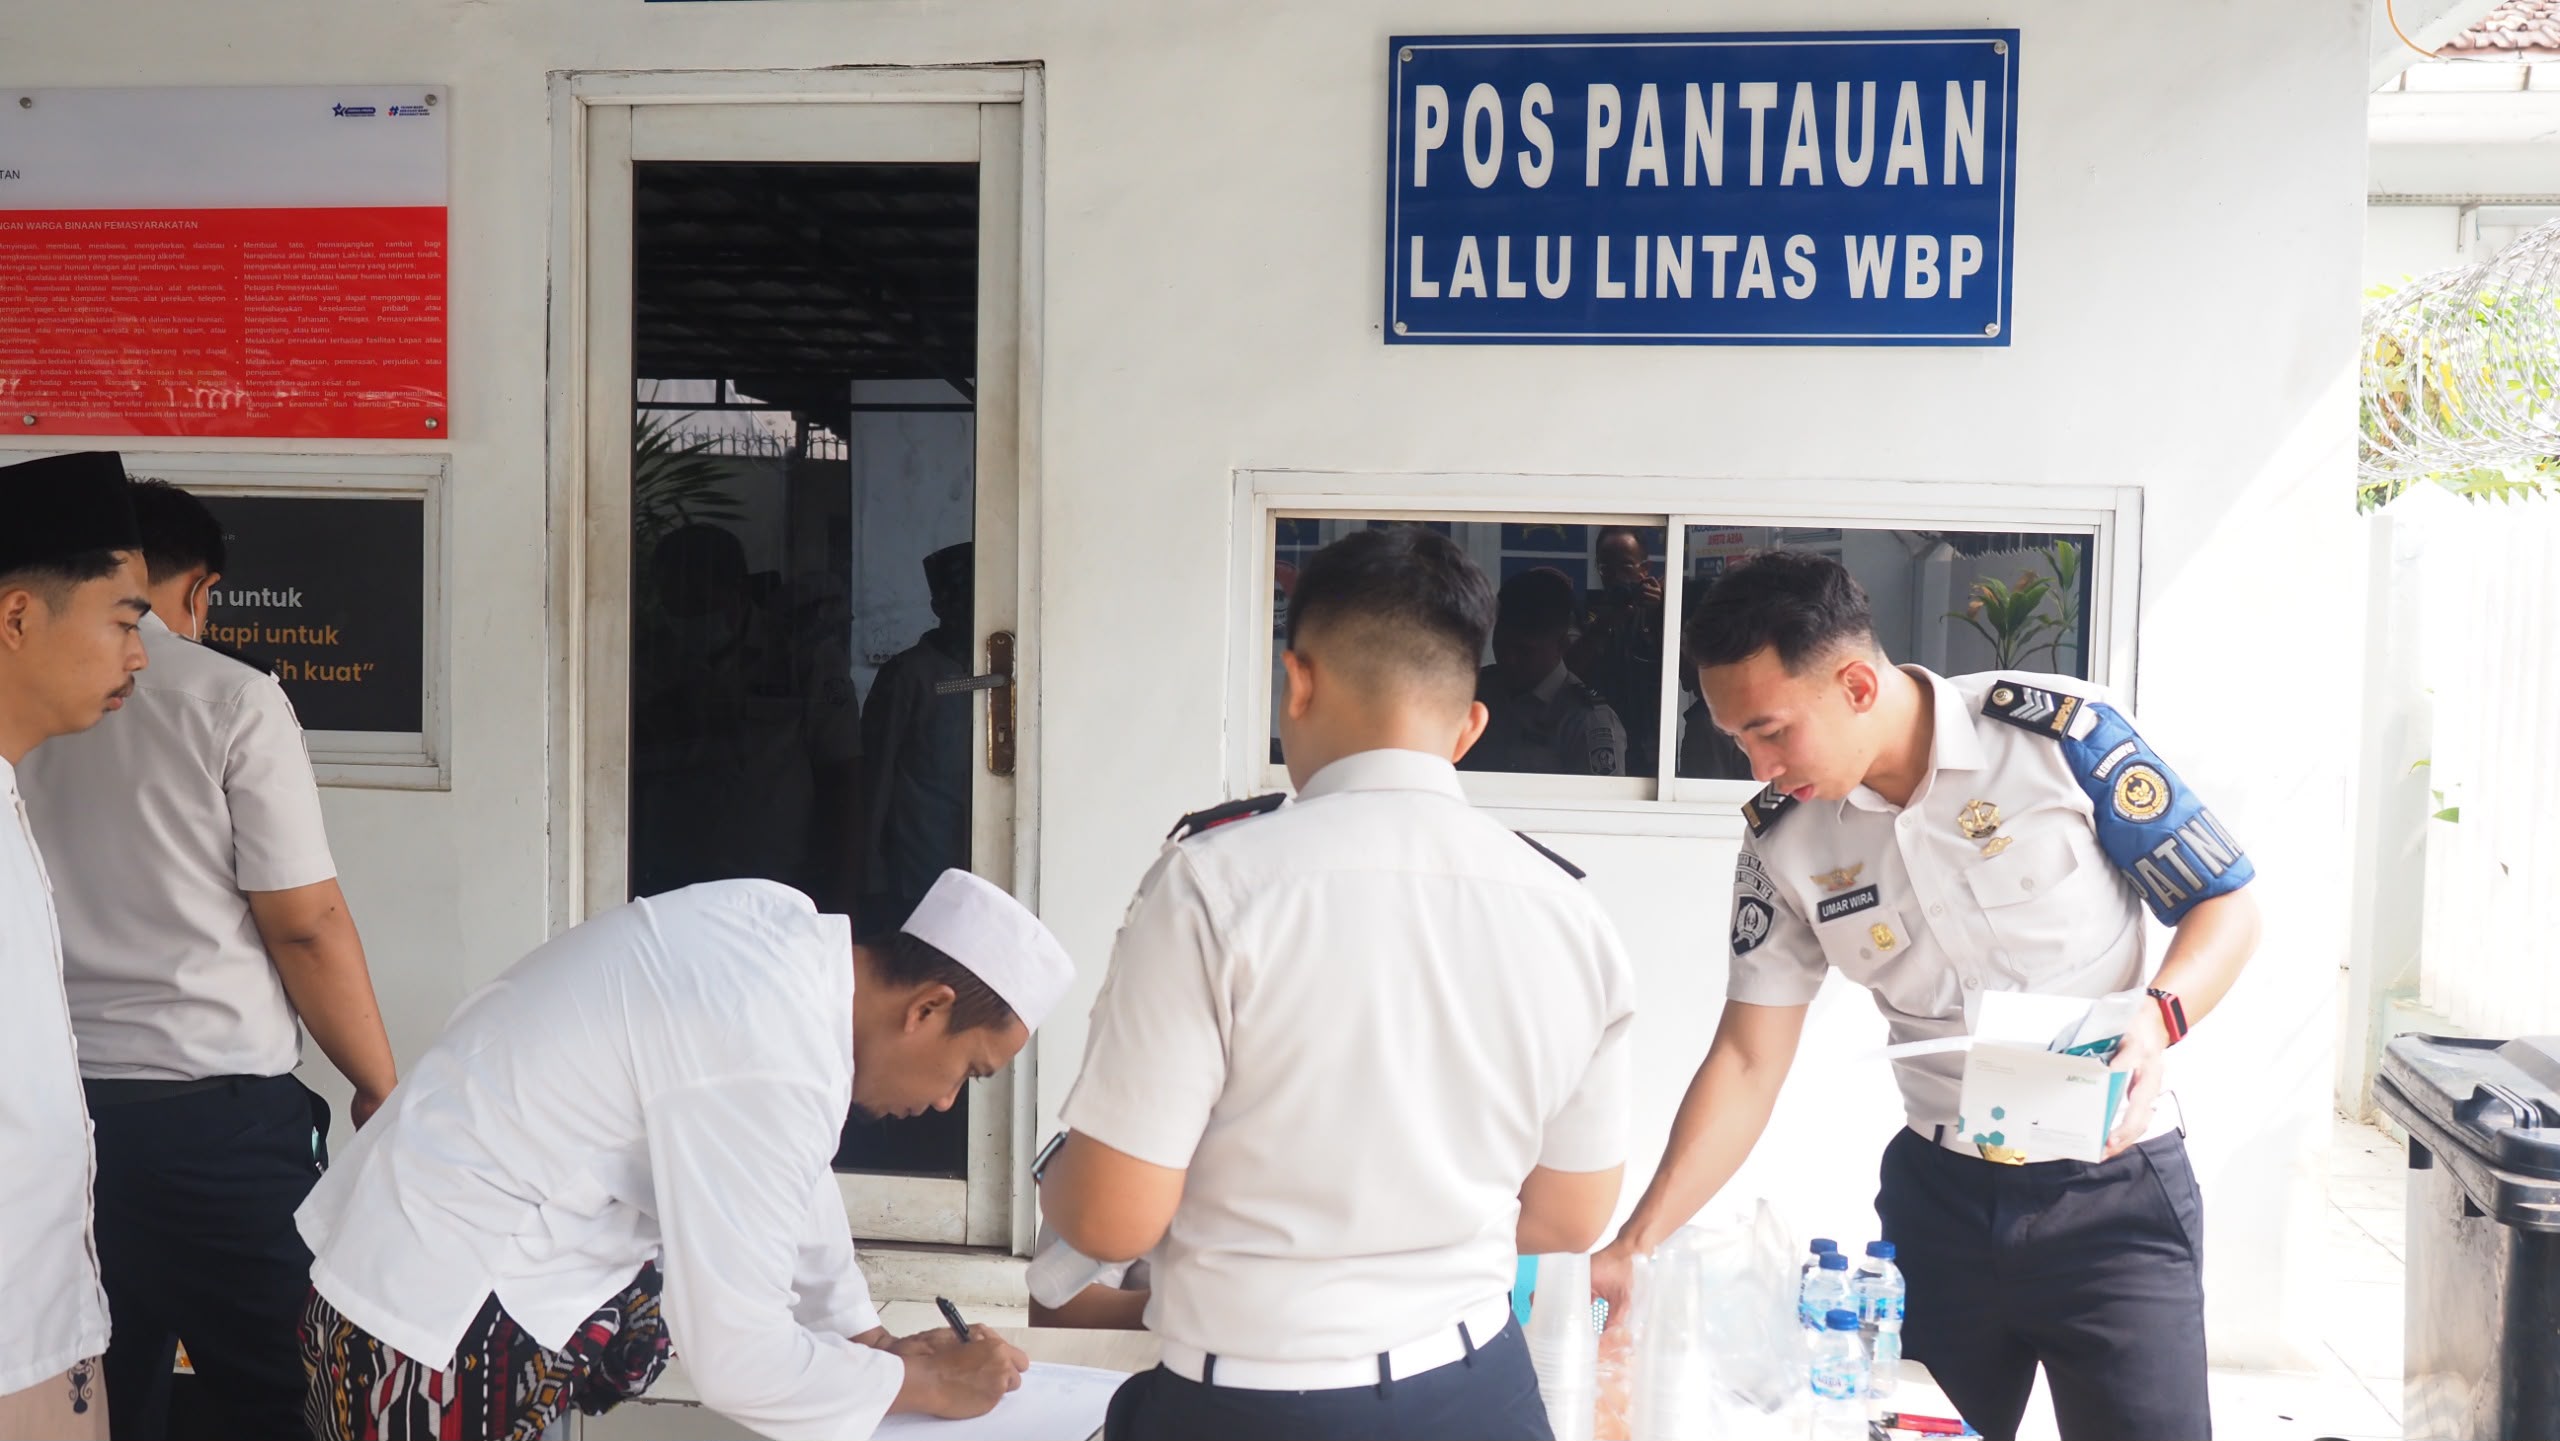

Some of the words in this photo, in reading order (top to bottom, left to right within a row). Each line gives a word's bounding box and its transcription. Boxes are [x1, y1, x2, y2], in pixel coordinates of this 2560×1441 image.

[1413, 82, 1554, 189] POS
[1586, 80, 1986, 187] PANTAUAN
[27, 222, 61, 230] WARGA
[65, 222, 101, 230] BINAAN
[105, 222, 198, 230] PEMASYARAKATAN
[89, 255, 106, 263] yang
[1410, 235, 1572, 300] LALU
[1597, 234, 1817, 300] LINTAS
[1845, 234, 1983, 299] WBP
[229, 587, 303, 608] untuk
[199, 622, 259, 649] etapi
[266, 624, 339, 646] untuk
[1822, 898, 1850, 917] UMAR
[1850, 891, 1875, 909] WIRA
